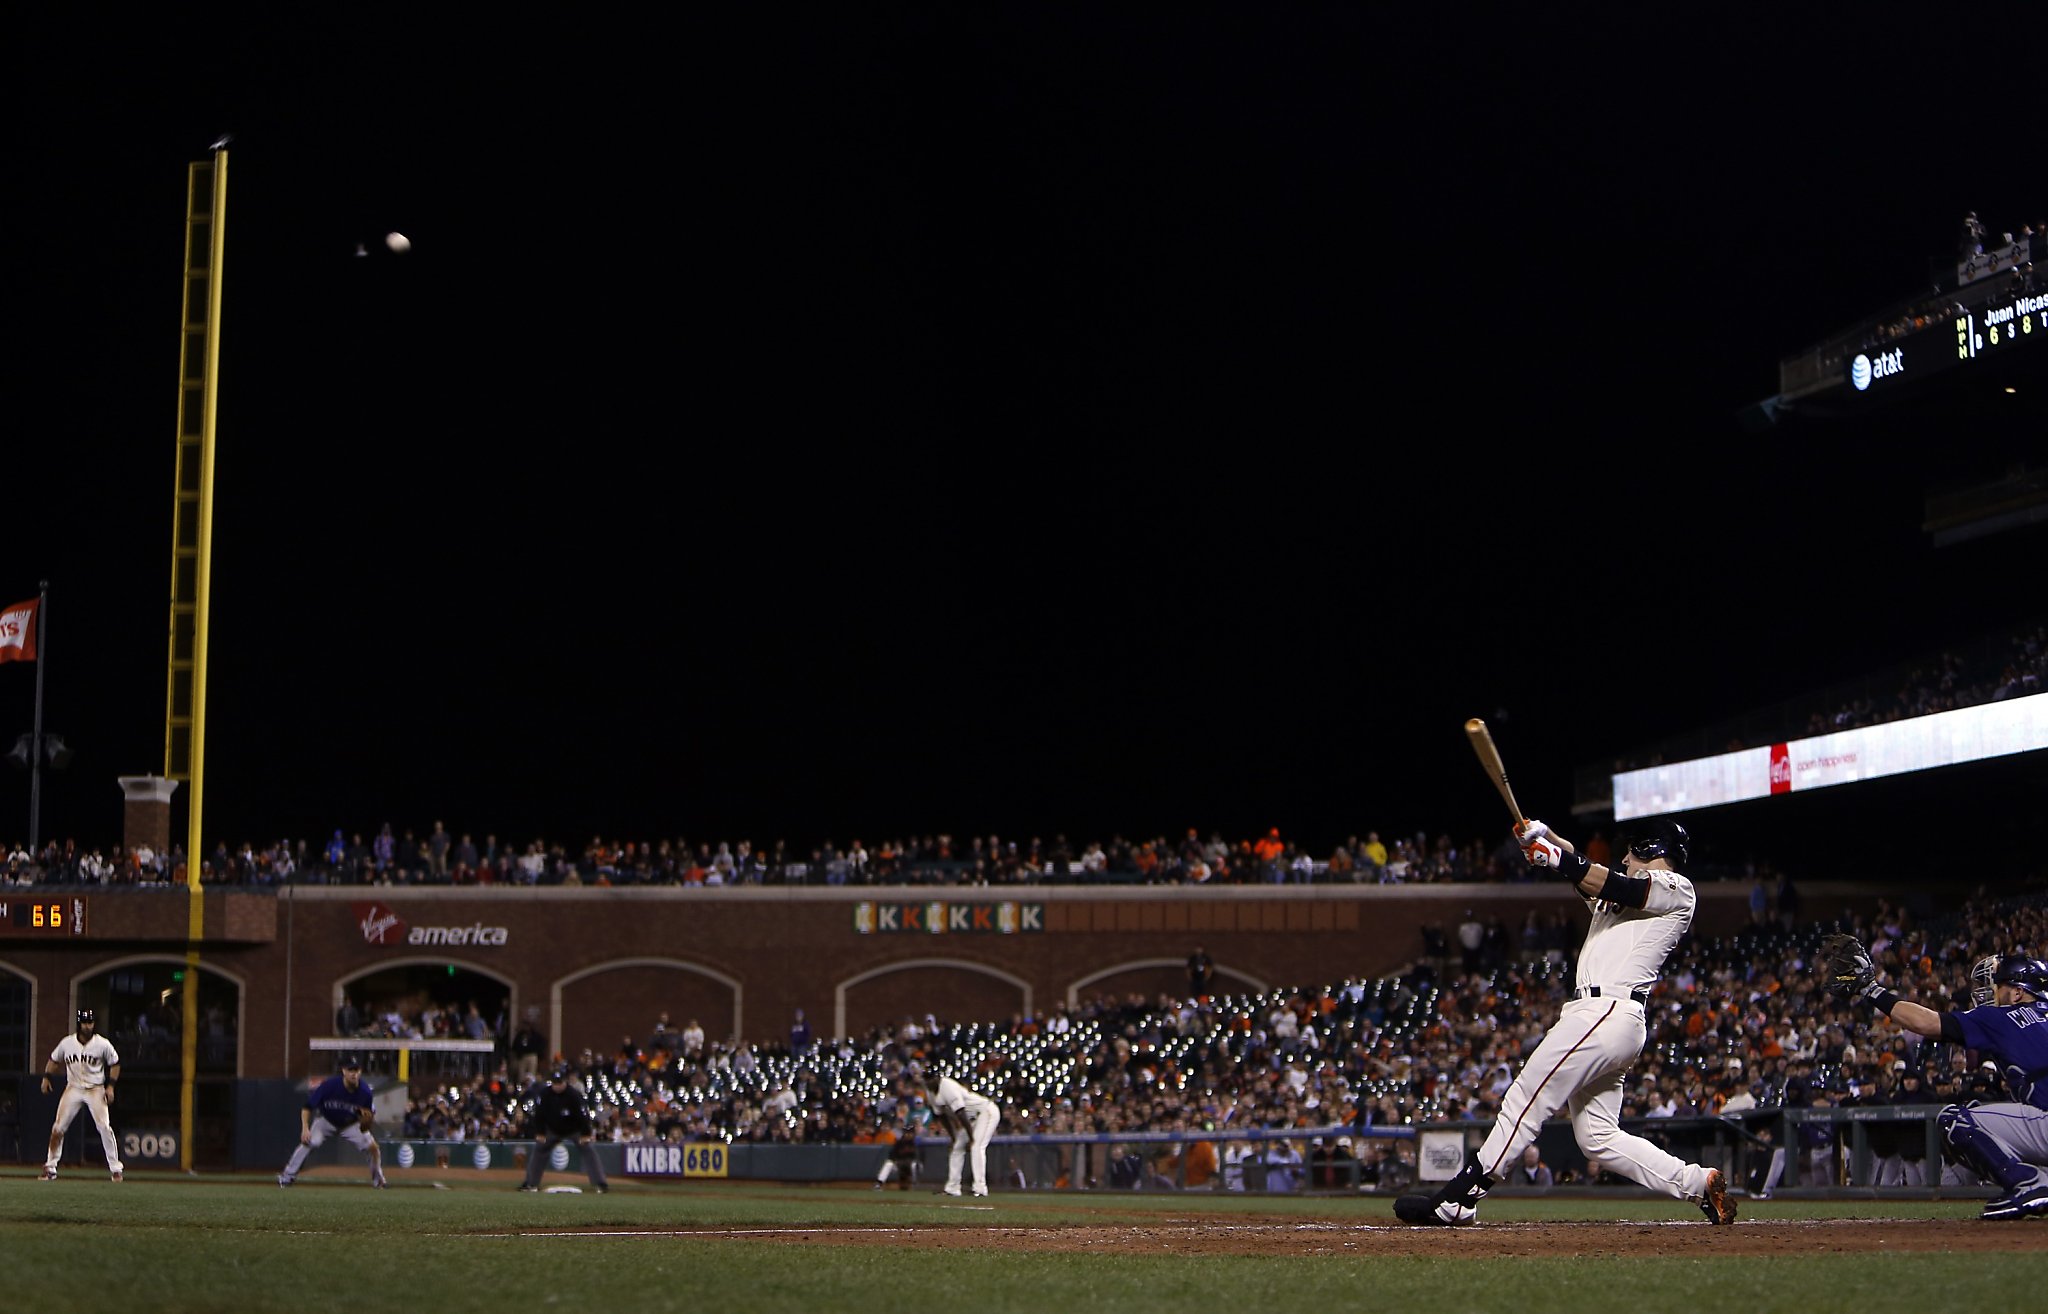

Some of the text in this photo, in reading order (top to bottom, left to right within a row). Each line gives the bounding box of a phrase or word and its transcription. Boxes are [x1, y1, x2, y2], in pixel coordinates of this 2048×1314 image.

[1984, 306, 2013, 327] Juan
[1990, 326, 1999, 345] 6
[2008, 322, 2015, 339] S
[2022, 315, 2032, 334] 8
[1873, 347, 1904, 379] at&t
[408, 922, 508, 945] america
[124, 1133, 176, 1158] 309
[627, 1147, 723, 1173] KNBR 680
